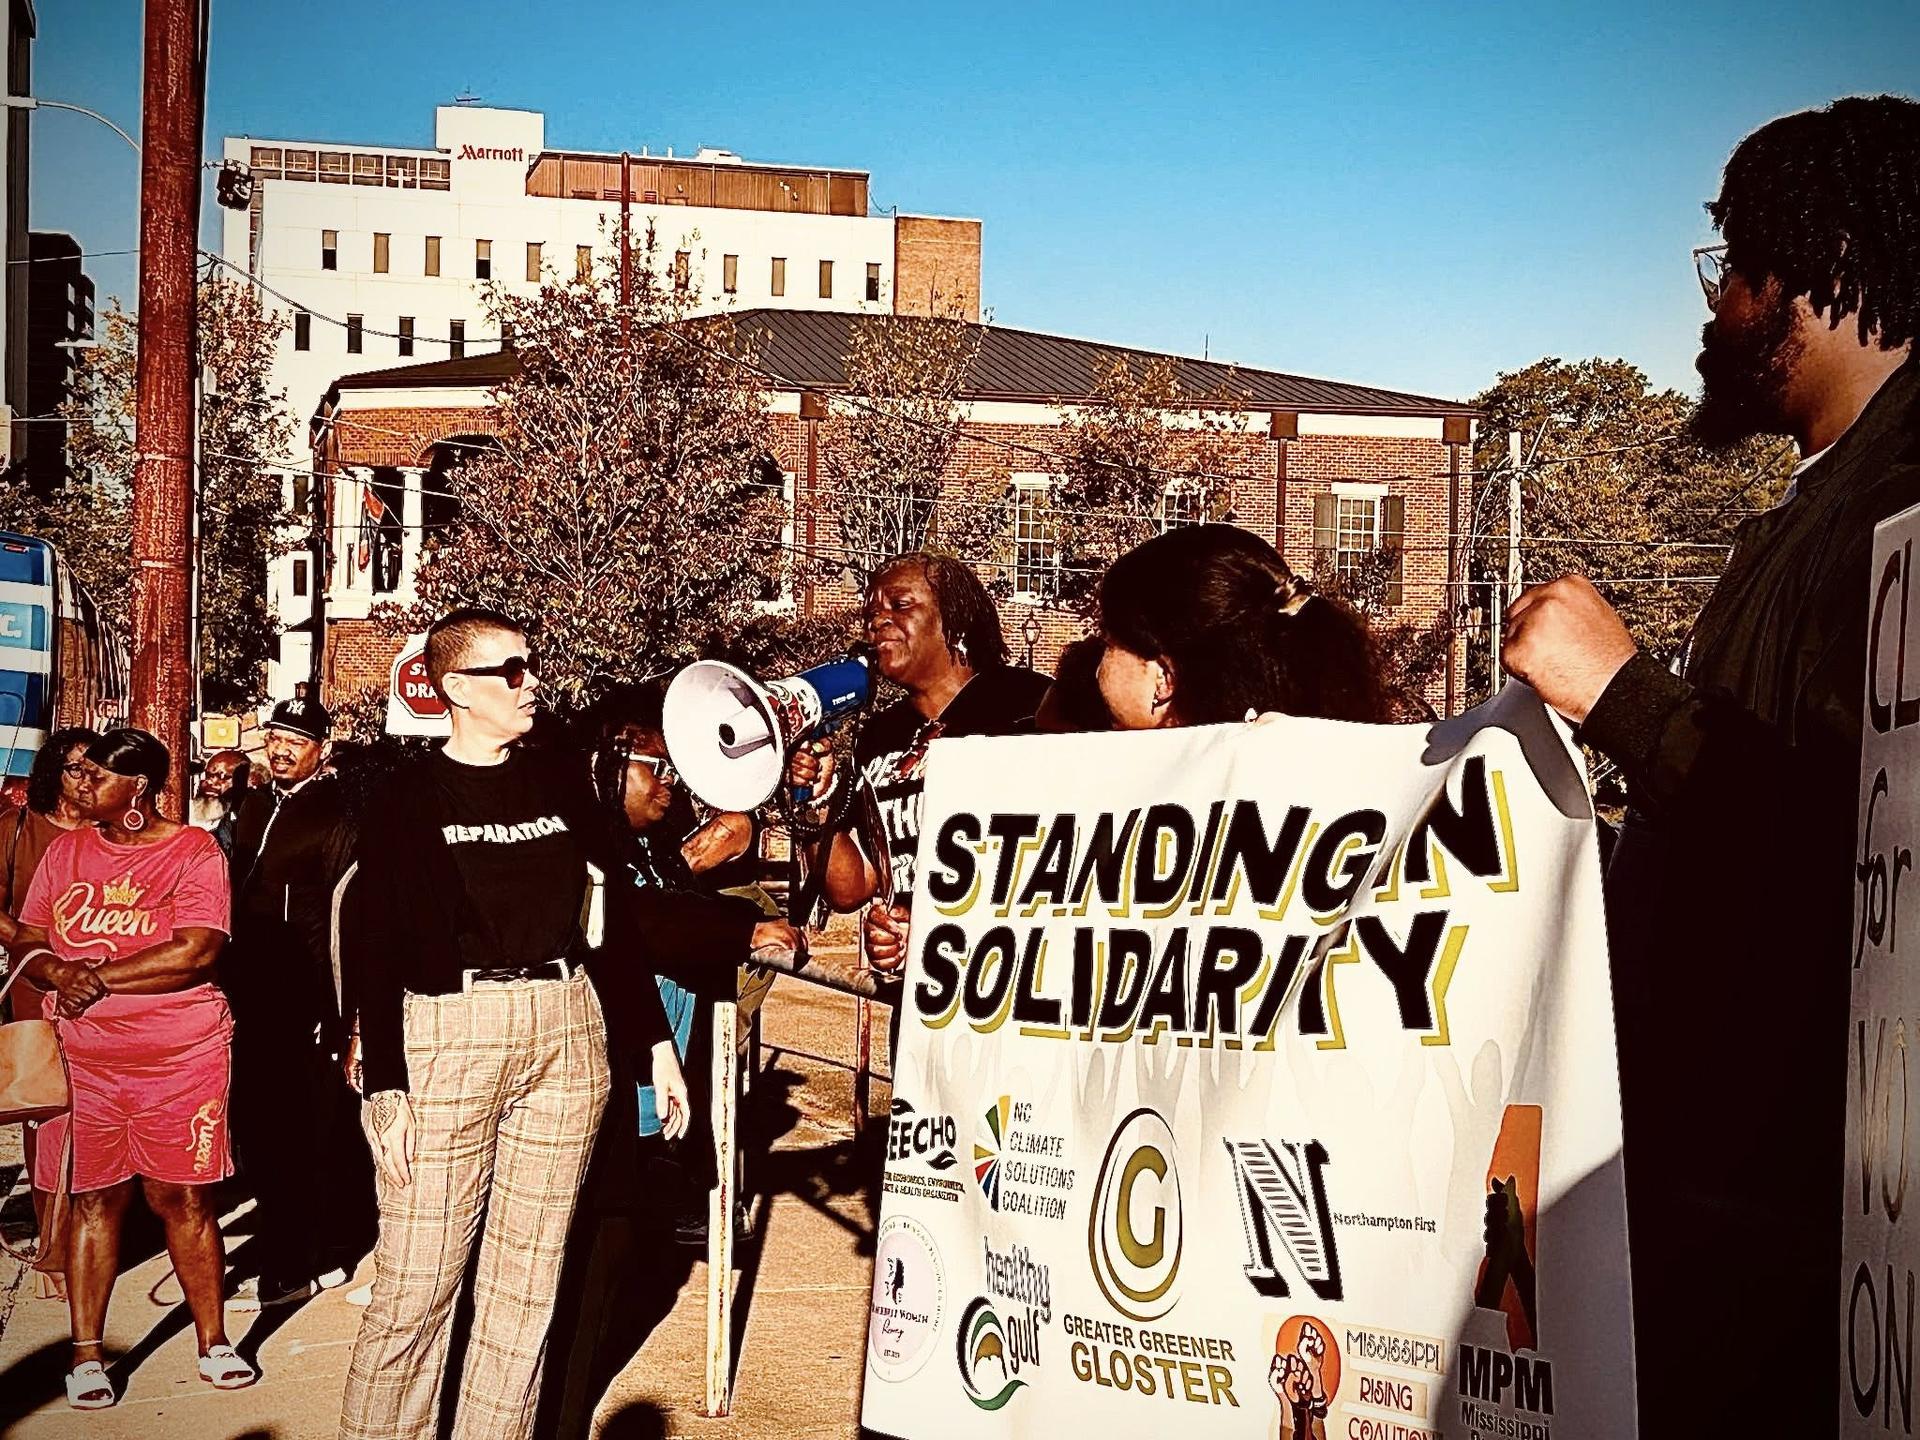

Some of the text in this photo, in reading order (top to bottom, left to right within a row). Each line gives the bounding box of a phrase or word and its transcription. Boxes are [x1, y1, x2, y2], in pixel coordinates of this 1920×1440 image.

[457, 144, 524, 162] Marriott
[928, 800, 1388, 922] STANDING
[1853, 766, 1913, 970] for
[52, 881, 159, 953] Queen
[915, 909, 1468, 1050] SOLIDARITY
[1013, 1101, 1032, 1123] NC
[1009, 1130, 1065, 1158] CLIMATE
[1004, 1160, 1076, 1191] SOLUTIONS
[1001, 1190, 1067, 1221] COALITION
[1222, 1136, 1345, 1302] N
[1333, 1212, 1436, 1233] Northampton First
[984, 1235, 1052, 1325] healthy
[1007, 1306, 1041, 1375] gulf
[1063, 1313, 1236, 1362] GREATER GREENER
[1346, 1329, 1440, 1371] MISSISSIPPI
[1848, 1261, 1915, 1434] ON
[1070, 1341, 1241, 1408] GLOSTER
[1359, 1376, 1413, 1412] RISING
[1458, 1344, 1554, 1415] MPM
[1461, 1401, 1552, 1440] Mississippi
